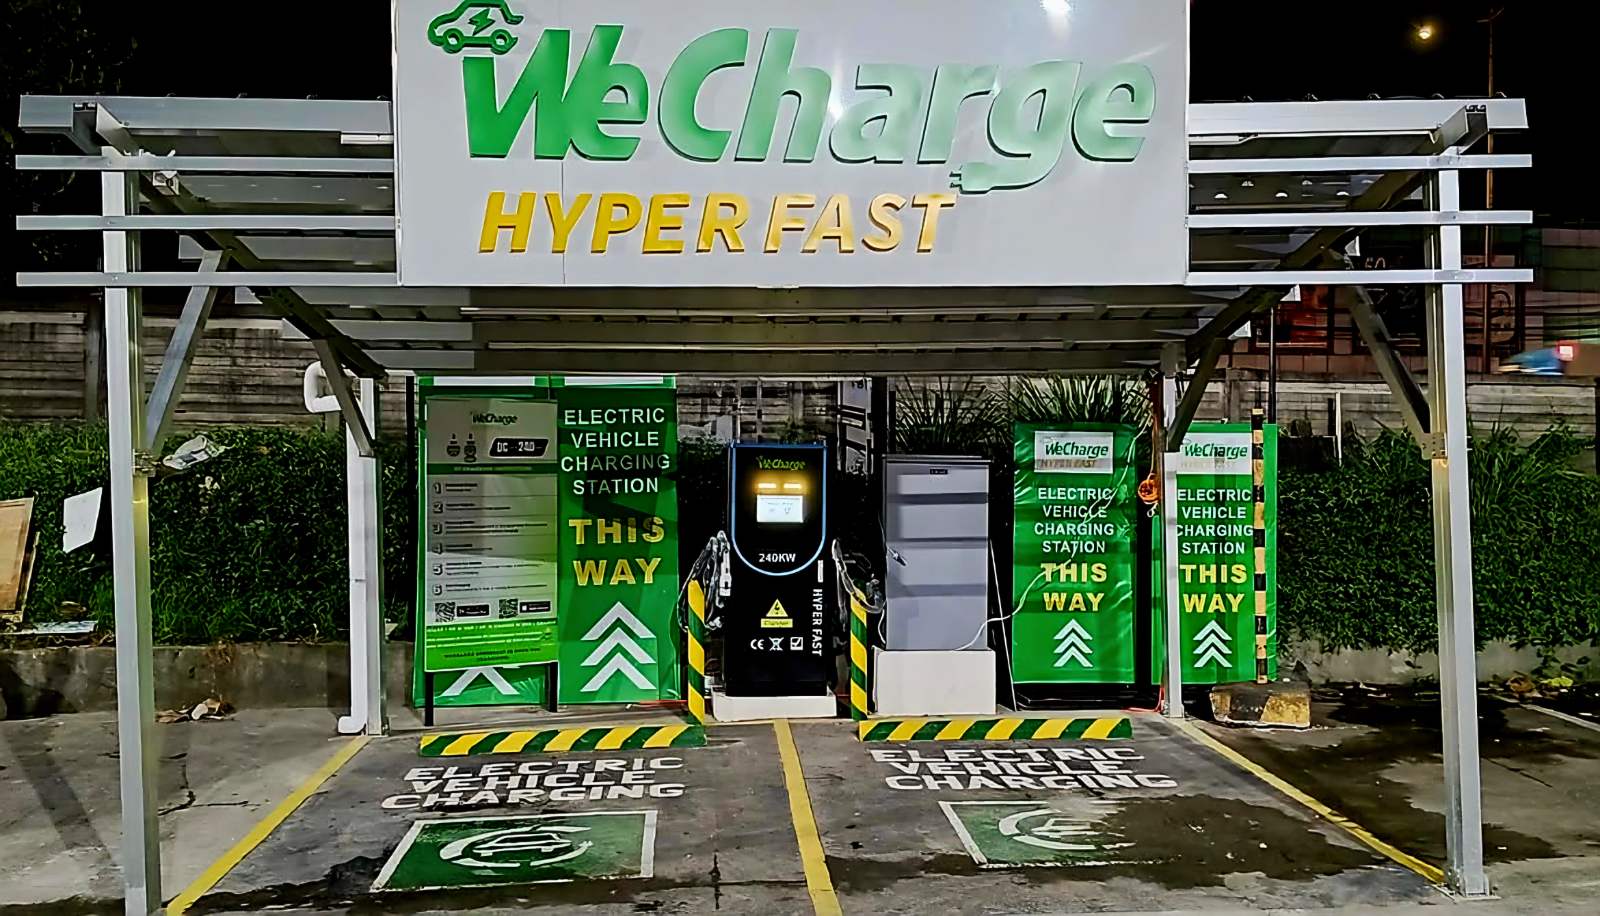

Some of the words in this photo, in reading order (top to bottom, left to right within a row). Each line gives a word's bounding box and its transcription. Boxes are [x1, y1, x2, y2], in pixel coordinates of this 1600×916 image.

[462, 25, 1157, 194] WeCharge
[478, 191, 747, 255] HYPER
[763, 192, 957, 254] FAST
[564, 408, 665, 424] ELECTRIC
[496, 441, 508, 453] DC
[571, 431, 659, 447] VEHICLE
[1045, 442, 1109, 459] WeCharge
[1185, 443, 1248, 460] WeCharge
[561, 454, 670, 472] CHARGING
[573, 477, 659, 494] STATION
[1038, 488, 1112, 500] ELECTRIC
[1177, 489, 1251, 501] ELECTRIC
[1043, 505, 1107, 518] VEHICLE
[1182, 507, 1247, 519] VEHICLE
[569, 517, 664, 545] THIS
[1034, 523, 1114, 536] CHARGING
[1177, 525, 1254, 537] CHARGING
[1042, 541, 1105, 553] STATION
[1182, 542, 1245, 555] STATION
[758, 553, 796, 562] 240KW
[572, 557, 662, 586] WAY
[1041, 563, 1107, 583] THIS
[1180, 564, 1247, 584] THIS
[812, 588, 823, 626] HYPER
[1043, 592, 1105, 612] WAY
[1183, 593, 1245, 613] WAY
[812, 628, 823, 656] FAST
[870, 748, 1145, 762] ELECTRIC
[404, 757, 684, 781] ELECTRIC
[889, 761, 1134, 775] VEHICLE
[411, 770, 655, 793] VEHICLE
[885, 775, 1178, 790] CHARGING
[380, 784, 686, 809] CHARGING
